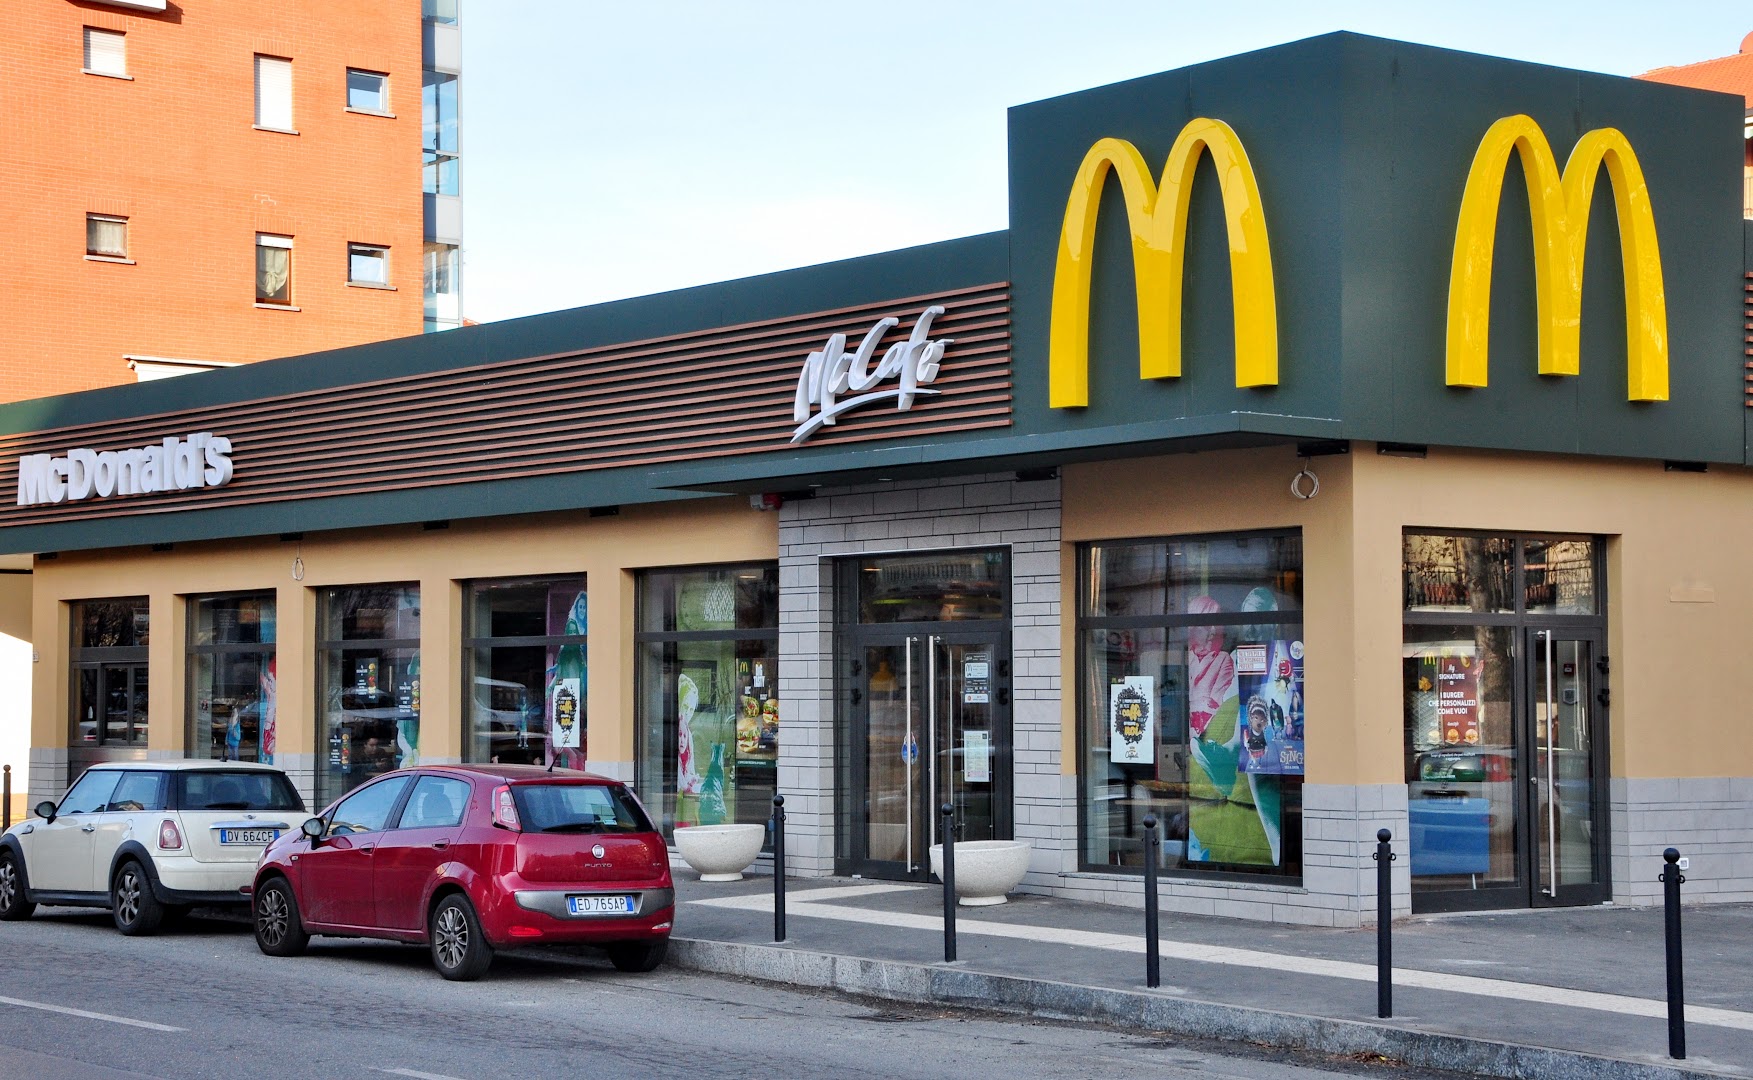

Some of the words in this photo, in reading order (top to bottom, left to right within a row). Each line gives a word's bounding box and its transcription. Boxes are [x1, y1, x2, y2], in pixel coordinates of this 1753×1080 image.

[17, 432, 233, 506] McDonald's
[1440, 699, 1476, 707] PERSONALIZZI
[1279, 750, 1304, 765] SING
[227, 831, 239, 842] DV
[243, 831, 273, 842] 664CF
[577, 898, 591, 911] ED
[593, 897, 625, 910] 765AP
